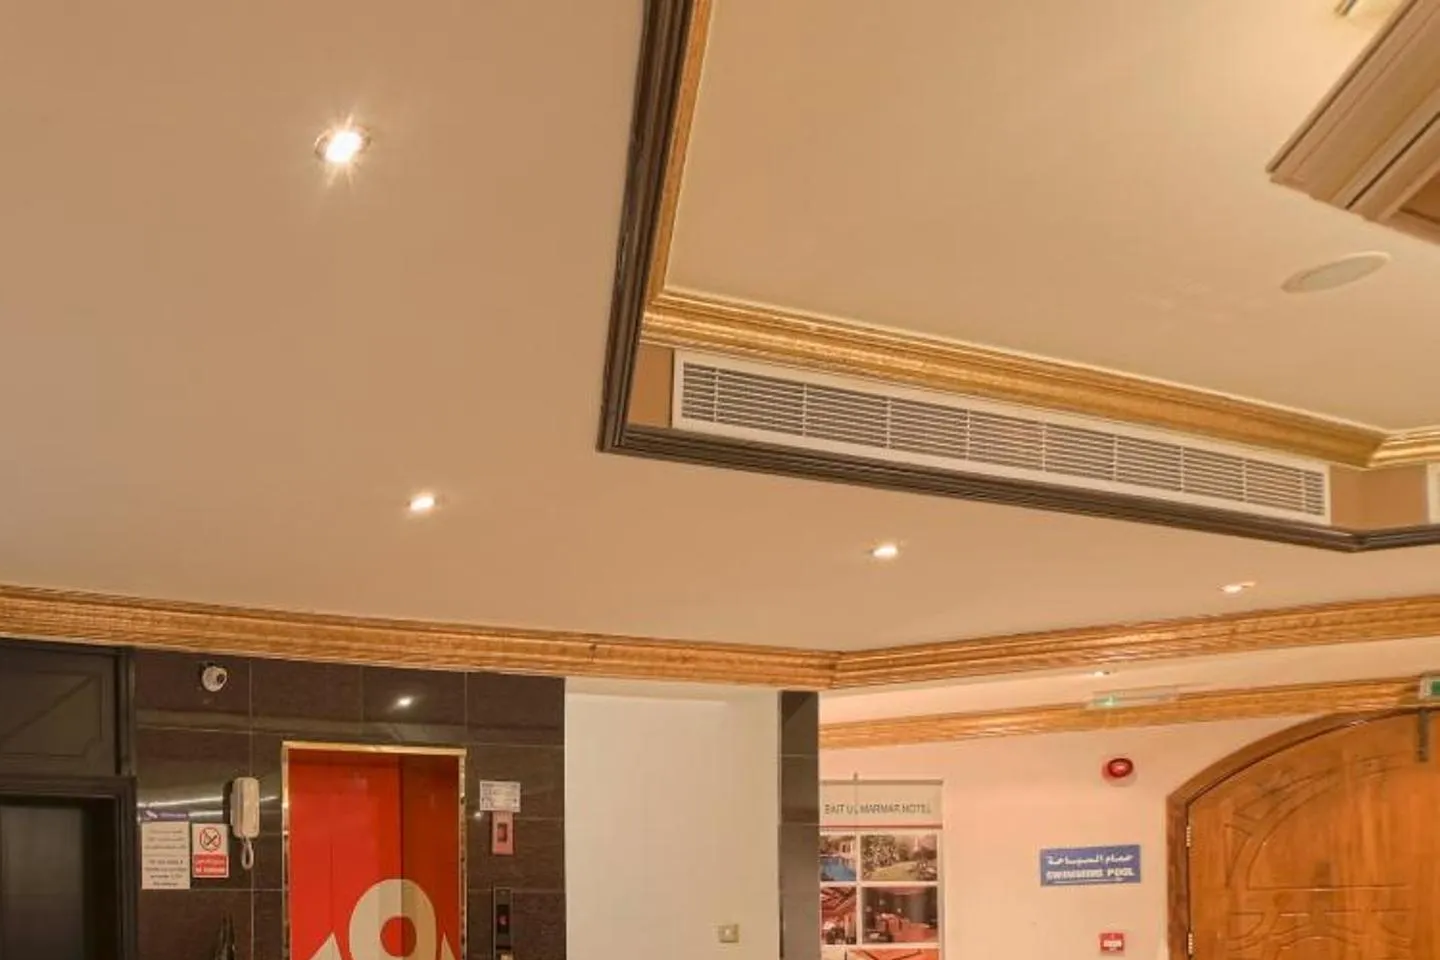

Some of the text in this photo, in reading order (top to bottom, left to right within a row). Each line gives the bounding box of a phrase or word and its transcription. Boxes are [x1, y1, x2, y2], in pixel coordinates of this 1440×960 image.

[902, 803, 932, 814] HOTEL
[1046, 867, 1135, 880] SWIMMING POOL
